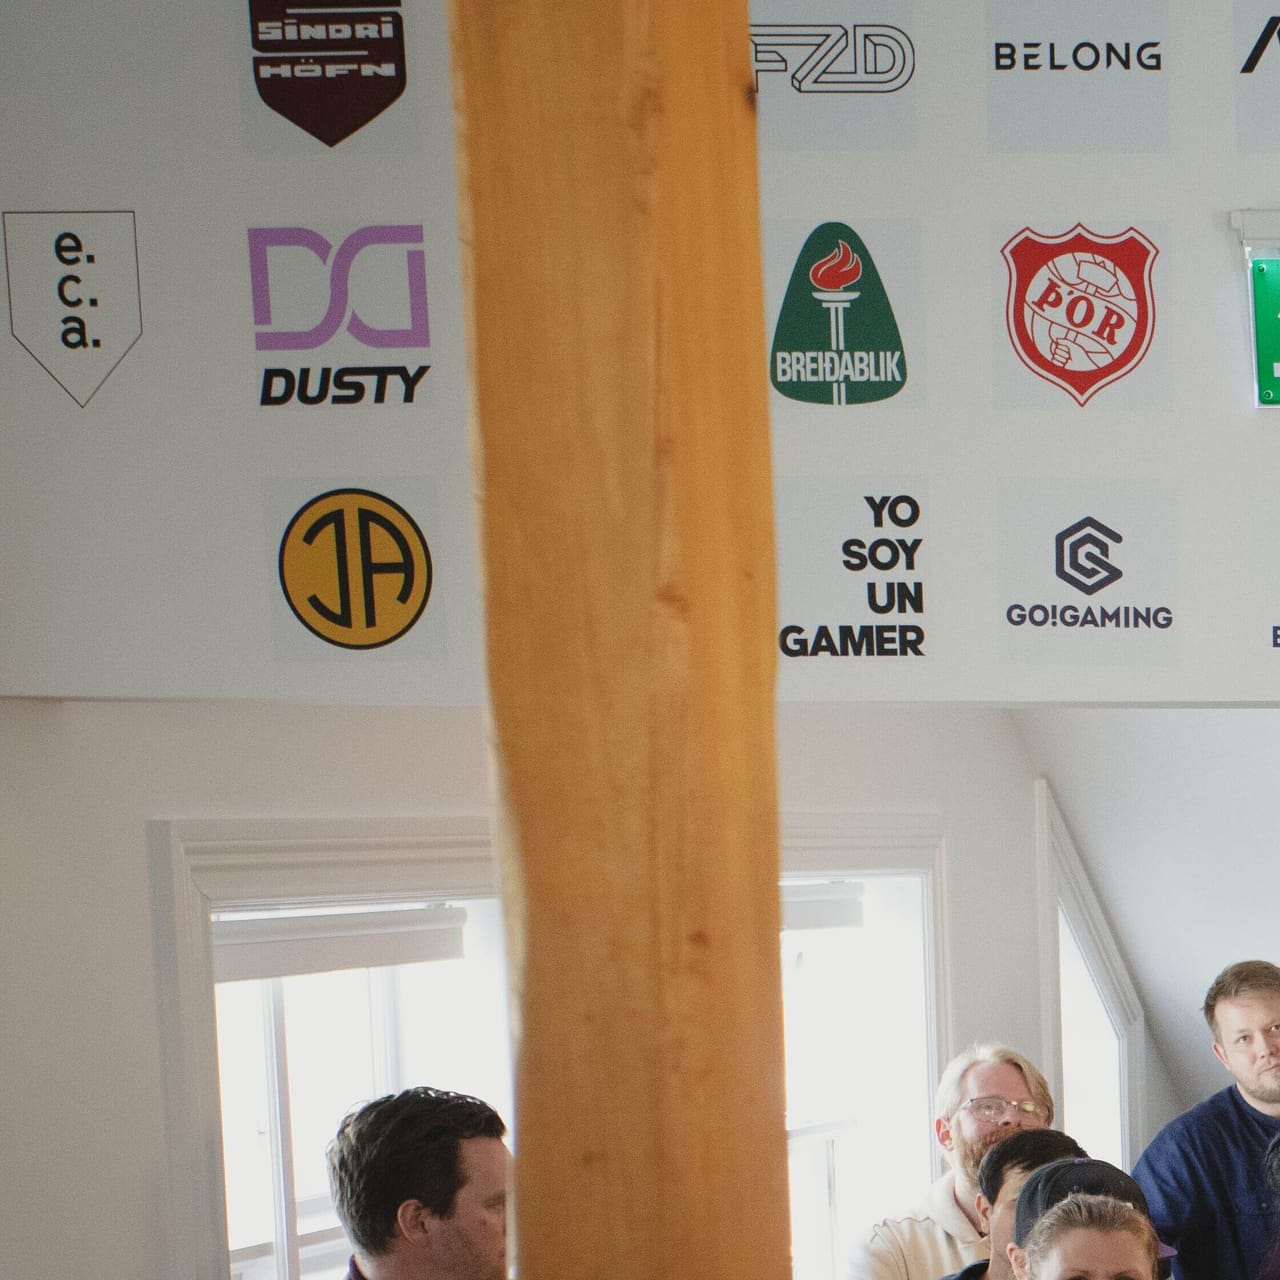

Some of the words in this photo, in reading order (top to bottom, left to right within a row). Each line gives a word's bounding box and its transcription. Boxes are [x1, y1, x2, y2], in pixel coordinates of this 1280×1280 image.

[259, 58, 396, 79] HÖFN
[994, 41, 1162, 71] BELONG
[260, 365, 431, 406] DUSTY
[864, 495, 921, 528] YO
[842, 538, 922, 571] SOY
[867, 582, 923, 613] UN
[1006, 603, 1173, 629] GO!GAMING
[779, 625, 925, 657] GAMER
